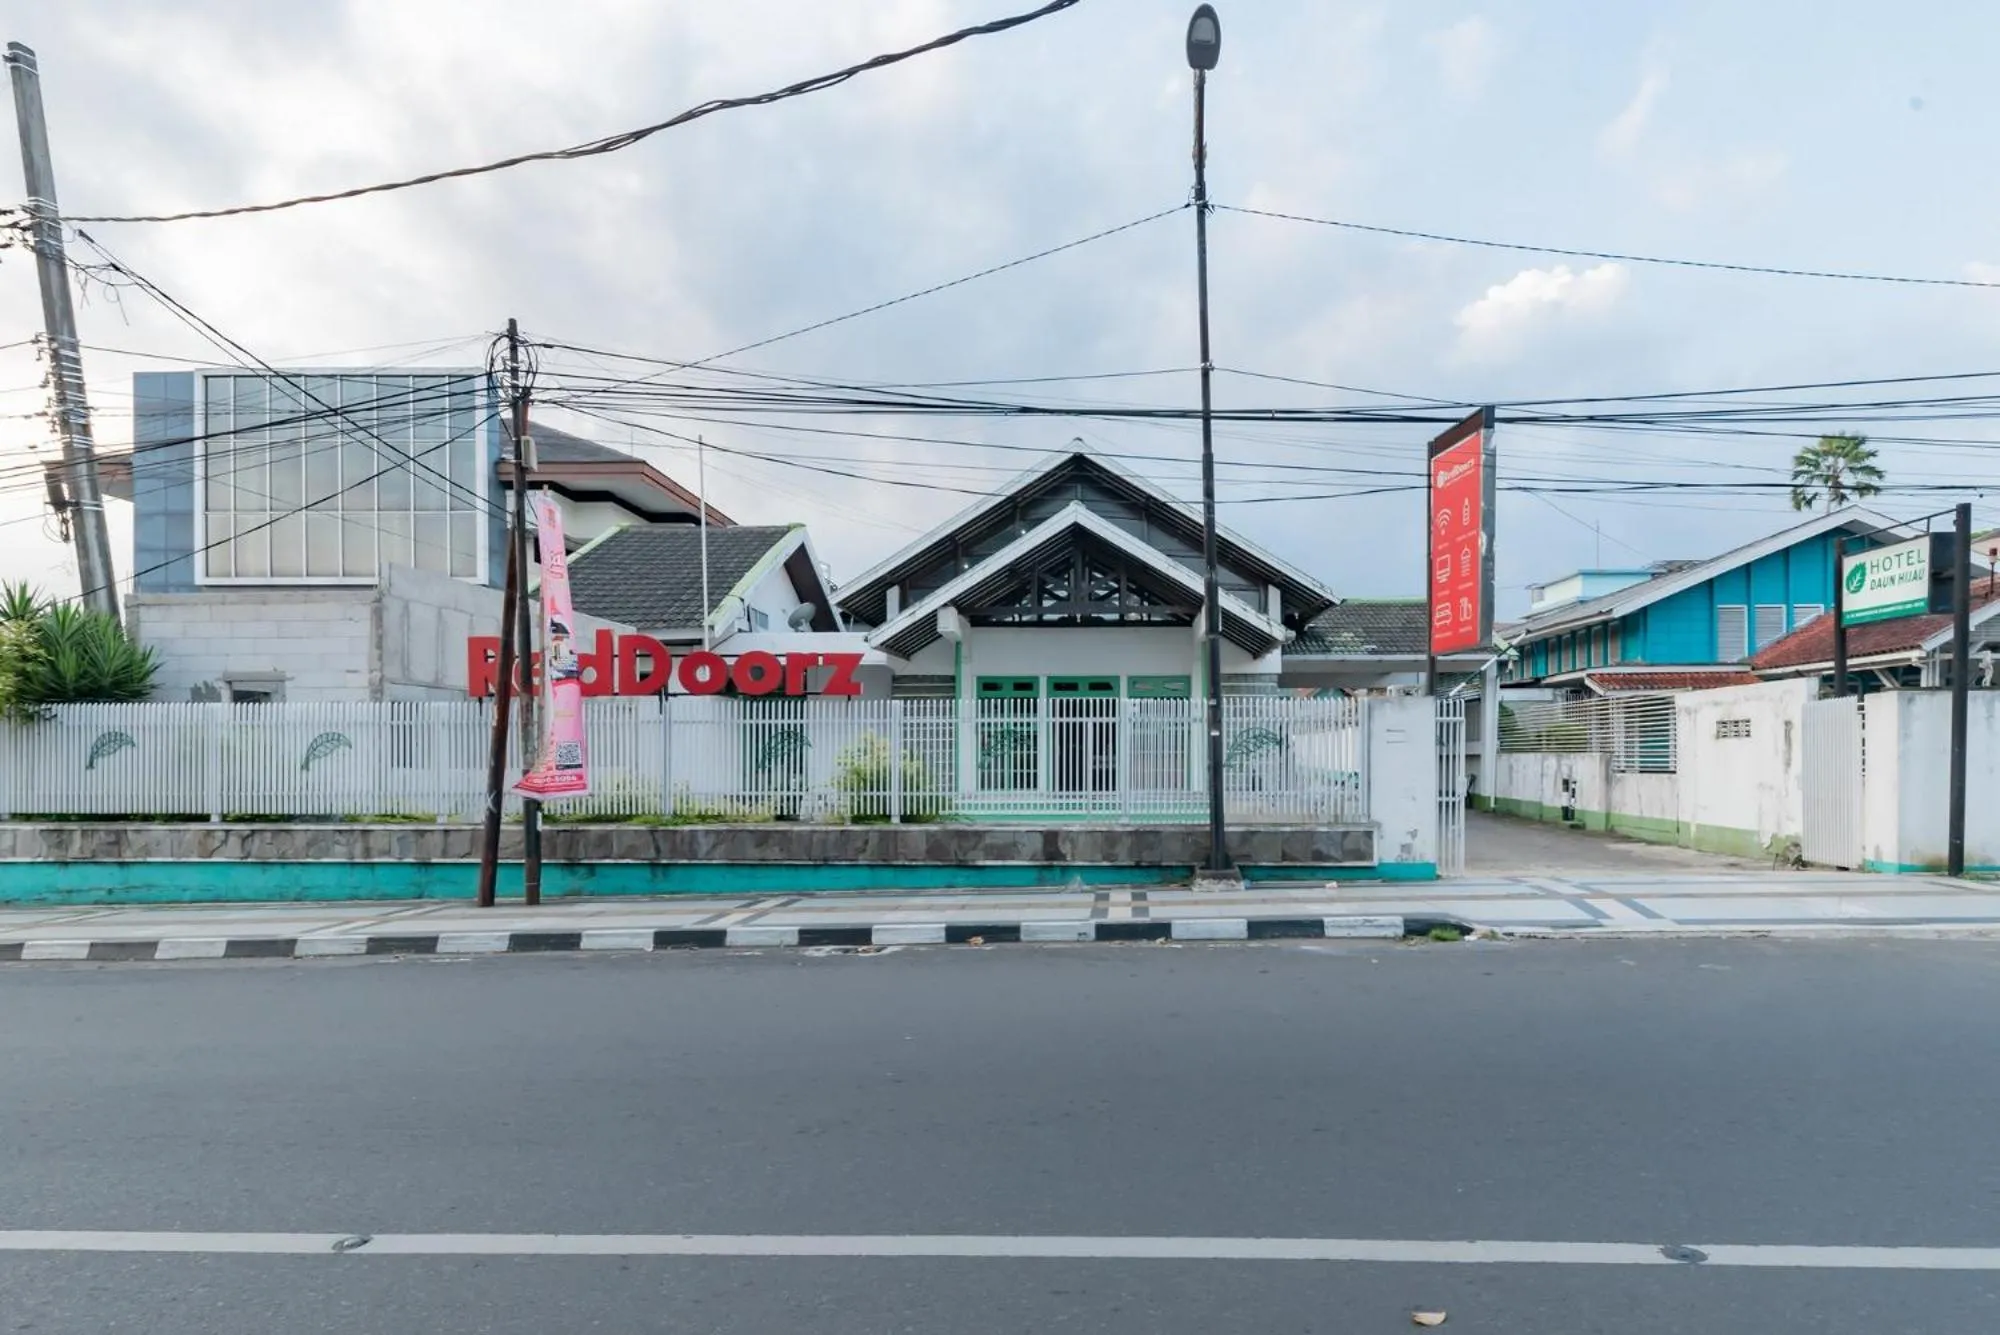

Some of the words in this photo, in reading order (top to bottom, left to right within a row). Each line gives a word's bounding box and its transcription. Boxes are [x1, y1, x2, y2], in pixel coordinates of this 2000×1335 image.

[1870, 549, 1925, 574] HOTEL
[1870, 575, 1896, 590] DAUN
[1898, 569, 1925, 587] HIJAU
[467, 629, 864, 696] RedDoorz
